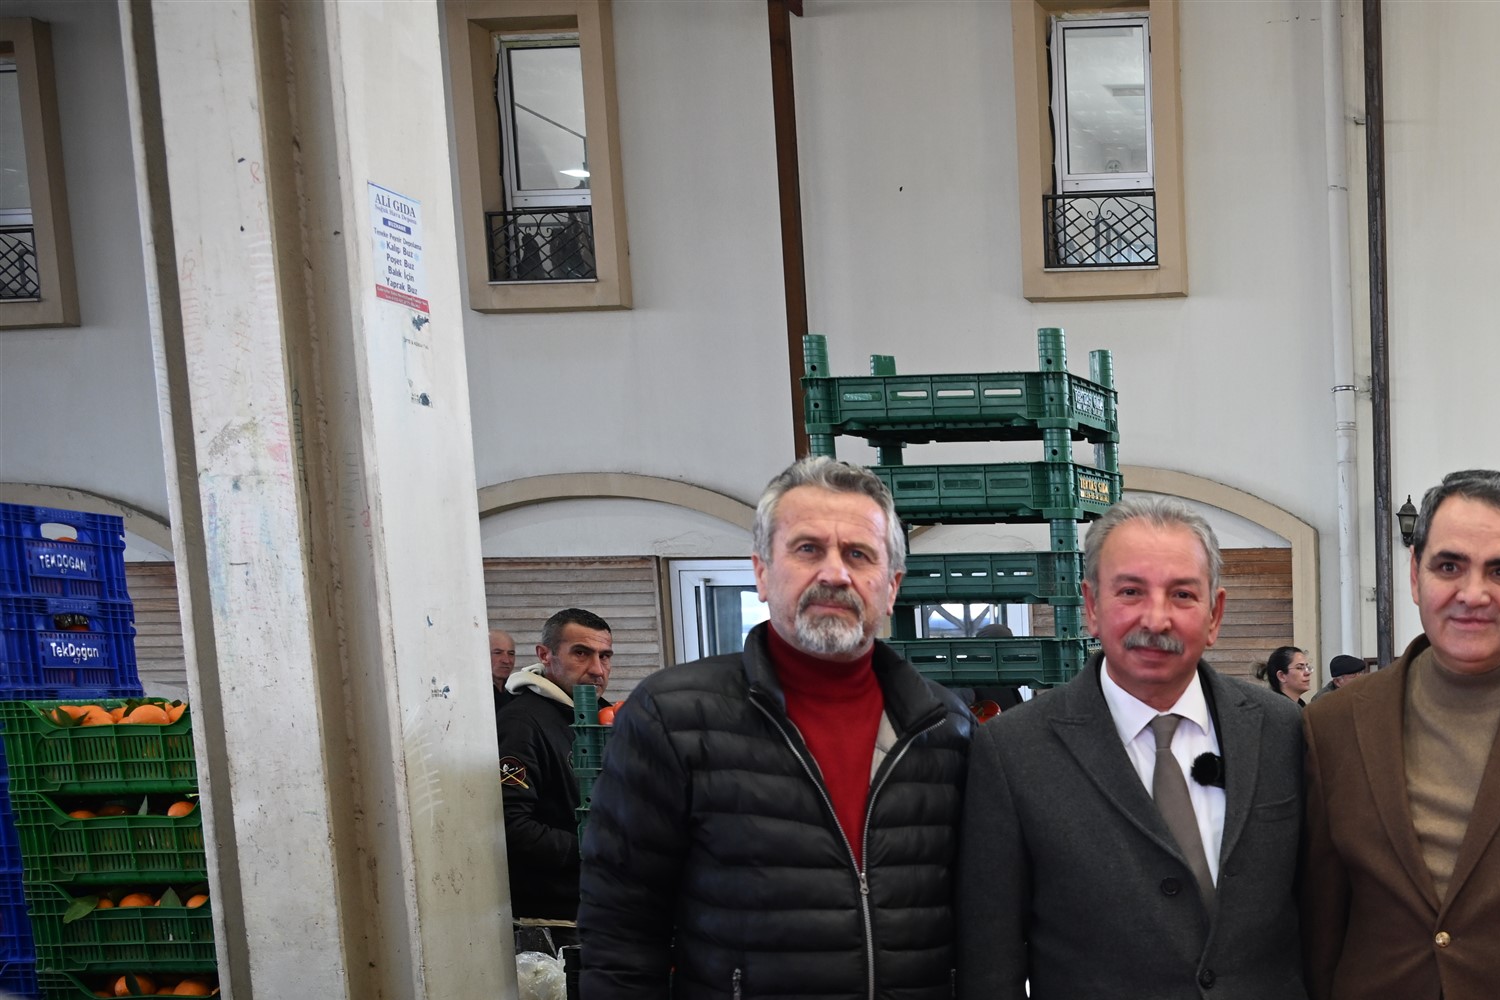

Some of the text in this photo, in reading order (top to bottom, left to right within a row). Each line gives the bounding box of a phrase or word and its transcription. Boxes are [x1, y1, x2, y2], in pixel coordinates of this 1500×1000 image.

[375, 193, 416, 218] ALİ GIDA
[402, 247, 414, 258] Buz
[403, 259, 415, 271] Buz
[386, 277, 418, 295] Yaprak Buz
[50, 642, 99, 660] TekDoğan
